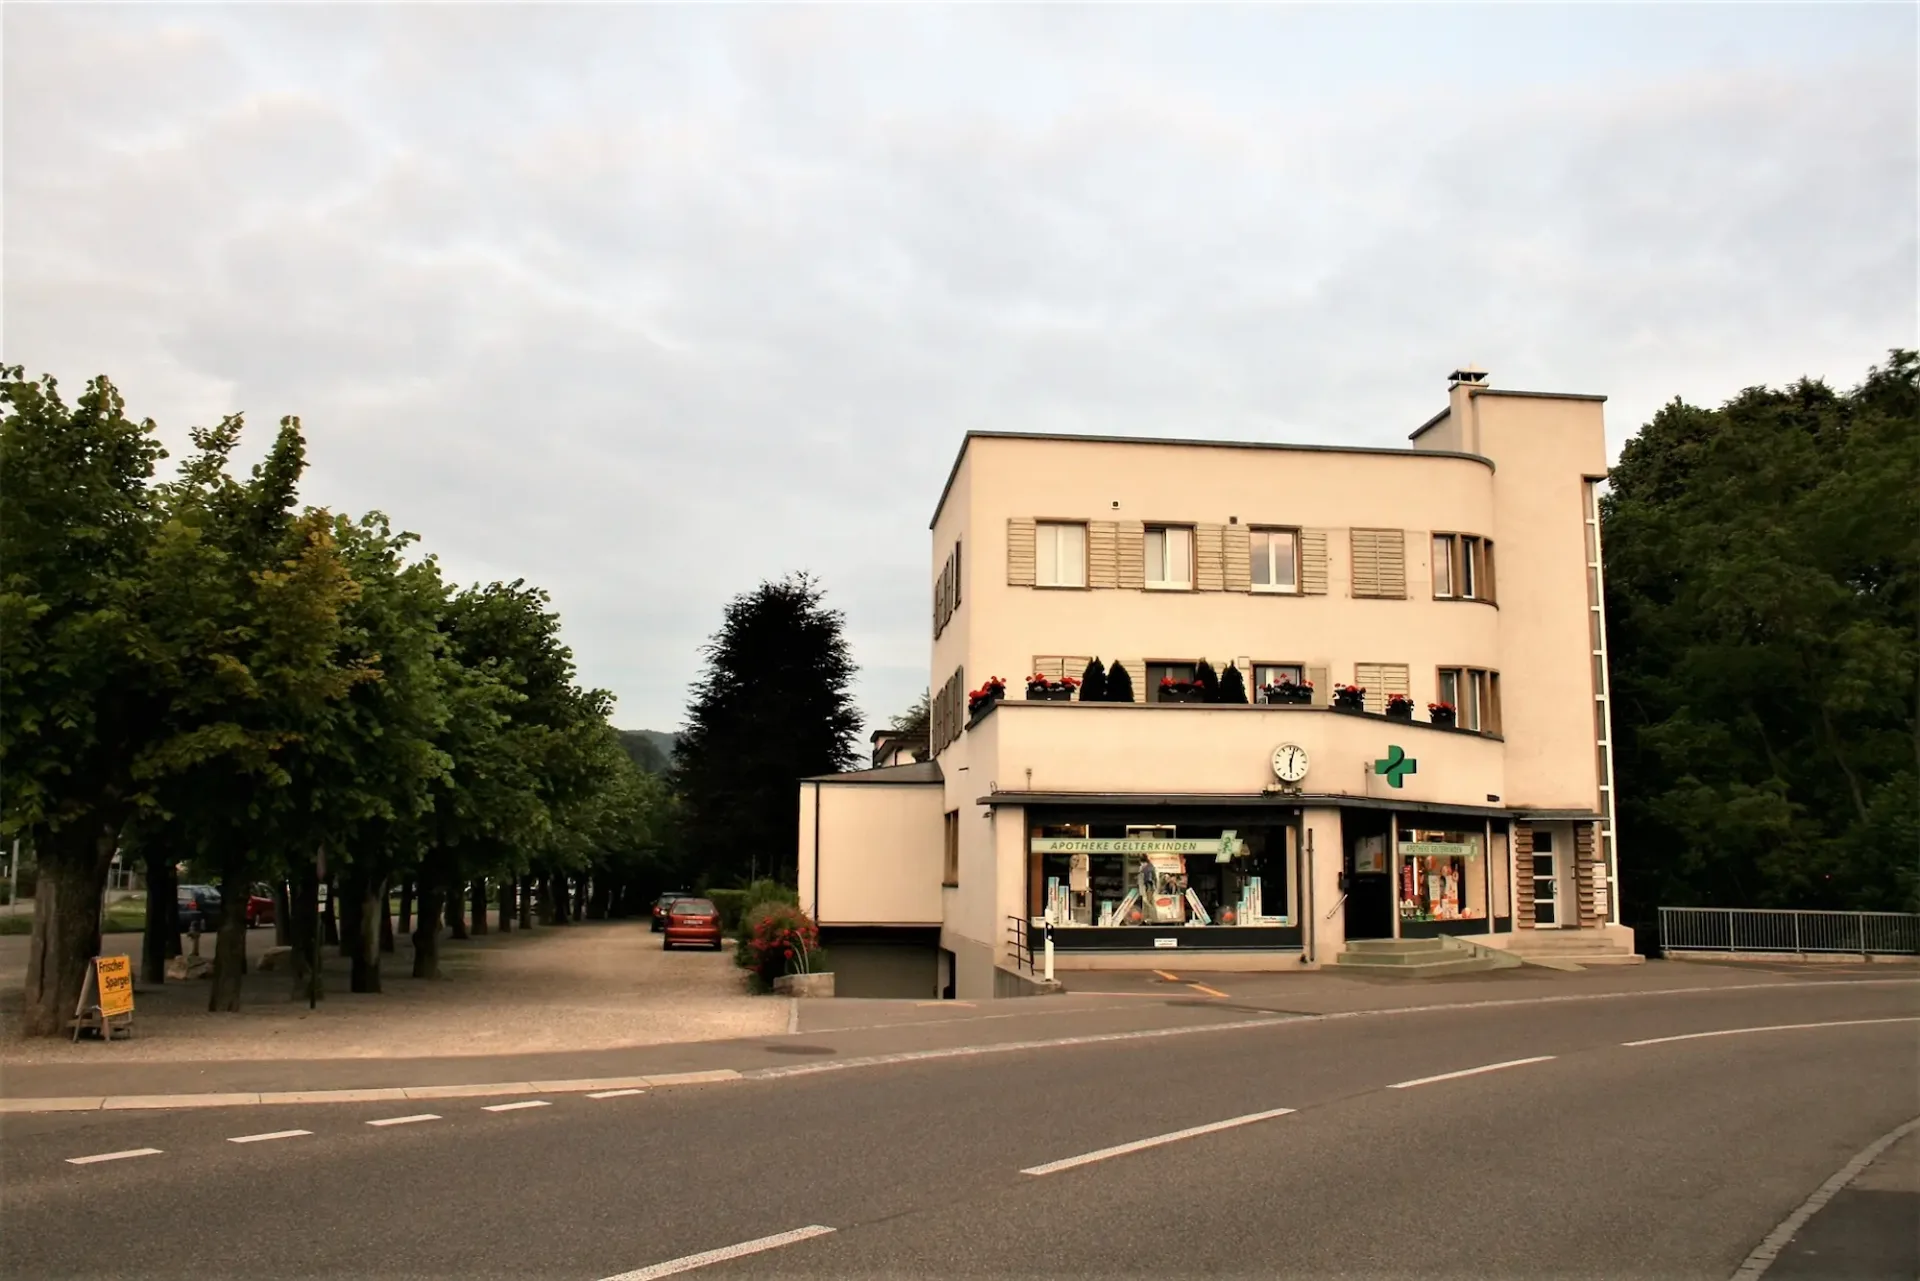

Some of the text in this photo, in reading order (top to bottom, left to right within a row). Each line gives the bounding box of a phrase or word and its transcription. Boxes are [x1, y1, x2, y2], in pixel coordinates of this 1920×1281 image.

[1051, 841, 1197, 851] APOTHEKE GELTERKINDEN
[98, 958, 125, 973] Frischer
